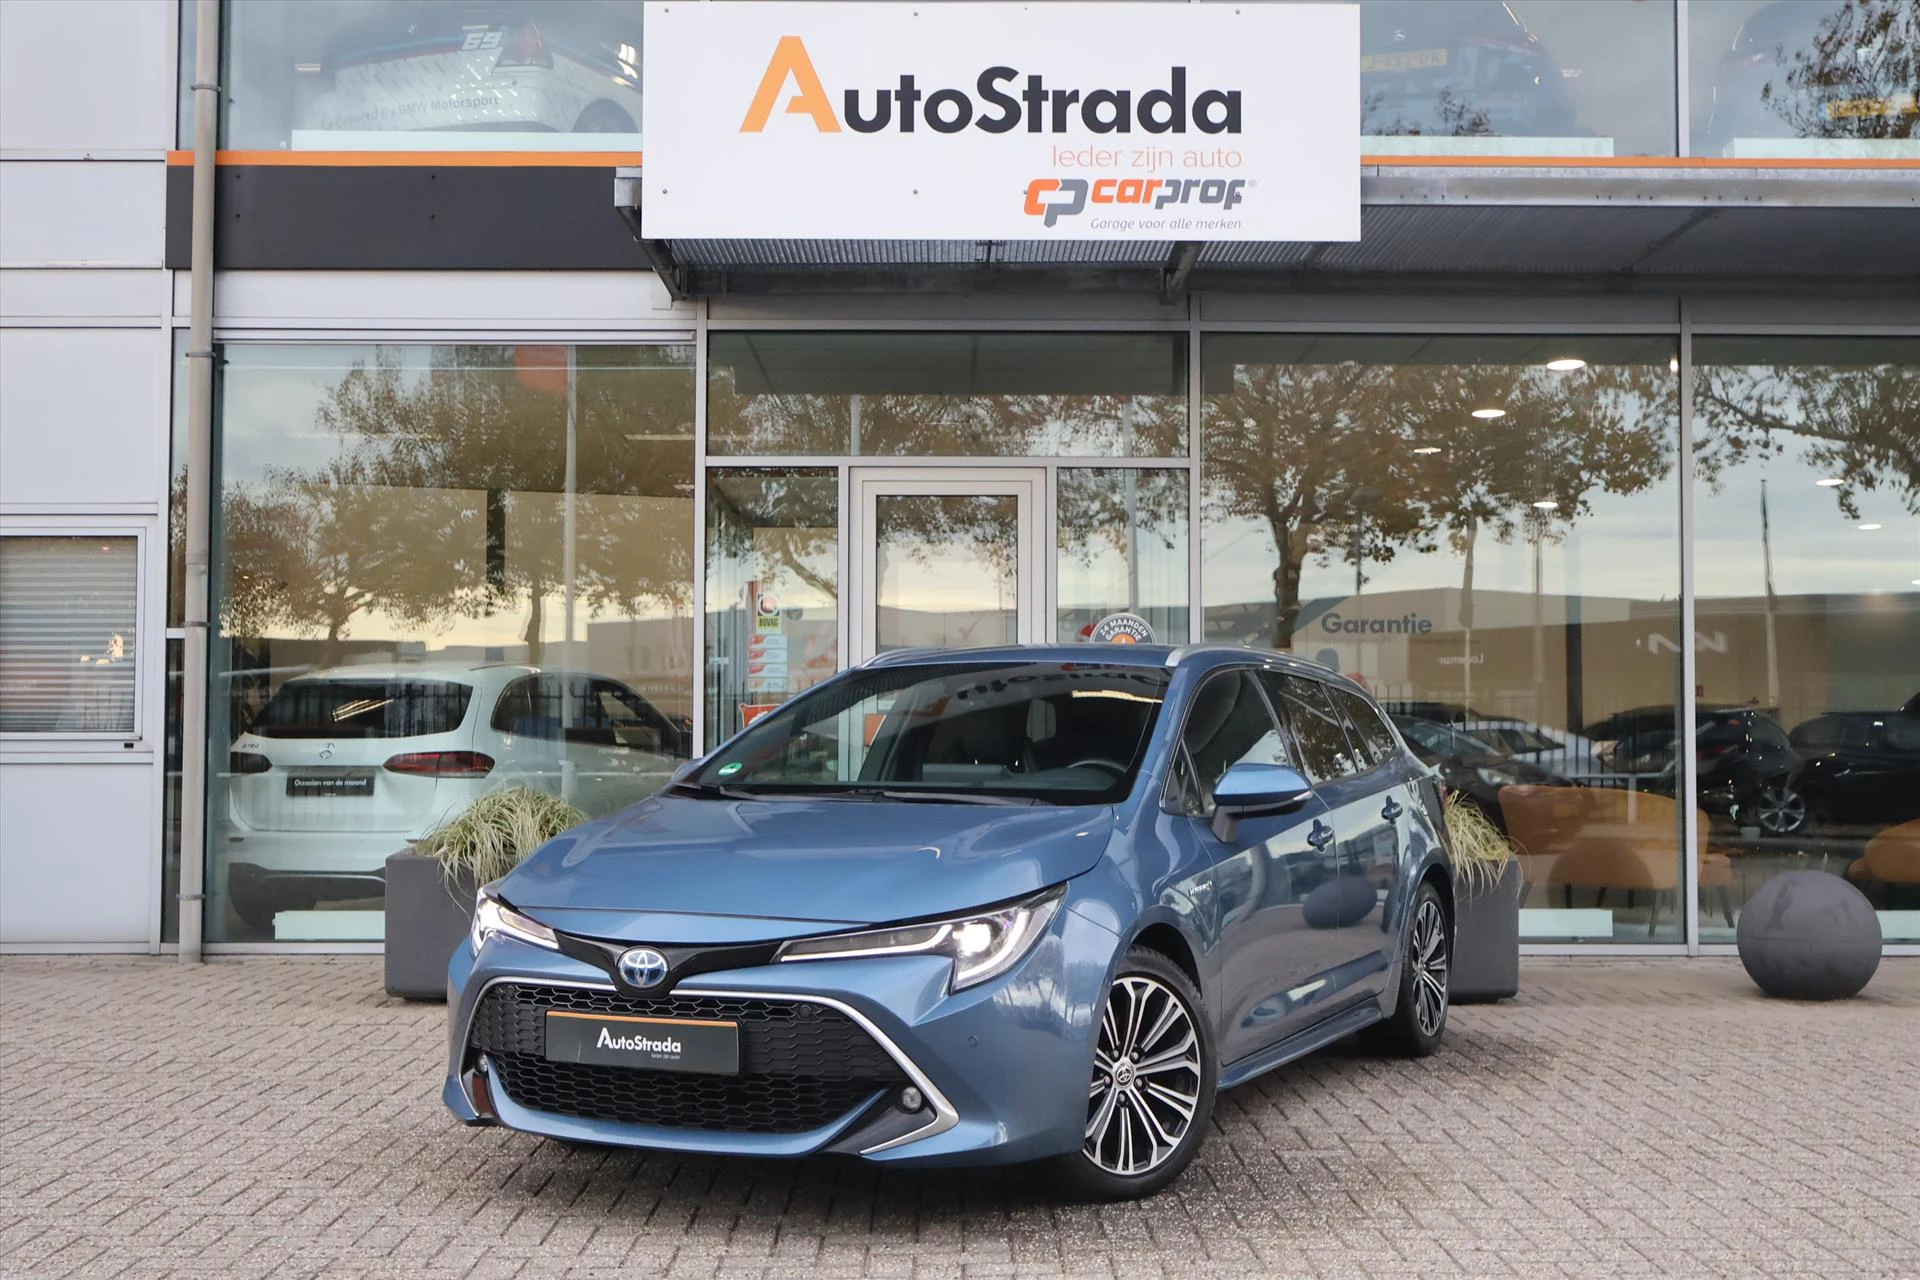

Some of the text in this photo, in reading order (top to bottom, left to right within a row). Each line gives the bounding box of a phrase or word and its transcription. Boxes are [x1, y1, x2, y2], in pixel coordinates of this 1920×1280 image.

[739, 35, 1243, 135] AutoStrada
[398, 101, 427, 116] BMW
[430, 95, 499, 112] Motorsport
[1053, 145, 1242, 173] Ieder zijn auto
[1091, 178, 1246, 210] carprof
[1091, 218, 1242, 232] Garage voor alle merken
[1099, 618, 1149, 637] 24 MAANDEN
[1105, 625, 1143, 641] GARANTIE
[1321, 612, 1433, 634] Garantie
[294, 778, 322, 786] Occasion
[335, 778, 344, 786] de
[345, 778, 367, 786] maand
[596, 1026, 682, 1053] AutoStrada
